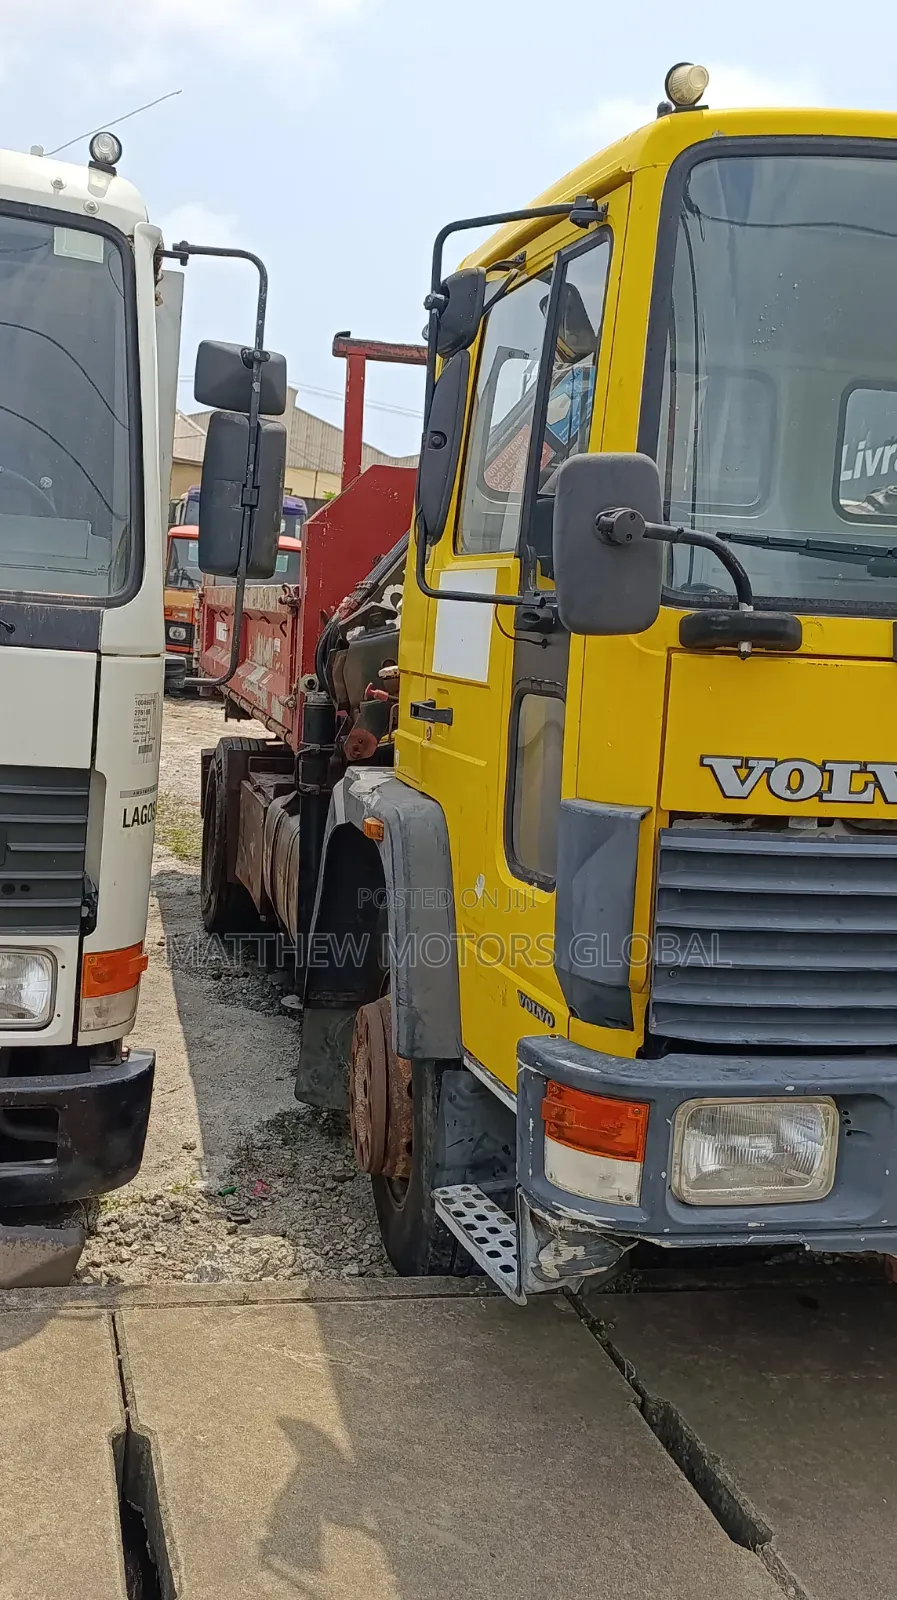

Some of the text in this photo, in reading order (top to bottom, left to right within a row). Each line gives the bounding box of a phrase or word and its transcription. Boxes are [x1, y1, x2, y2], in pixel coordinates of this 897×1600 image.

[487, 435, 525, 477] UITSLUITEND
[840, 440, 897, 482] Livr
[489, 467, 508, 487] VOOR
[517, 989, 555, 1028] VOLVO
